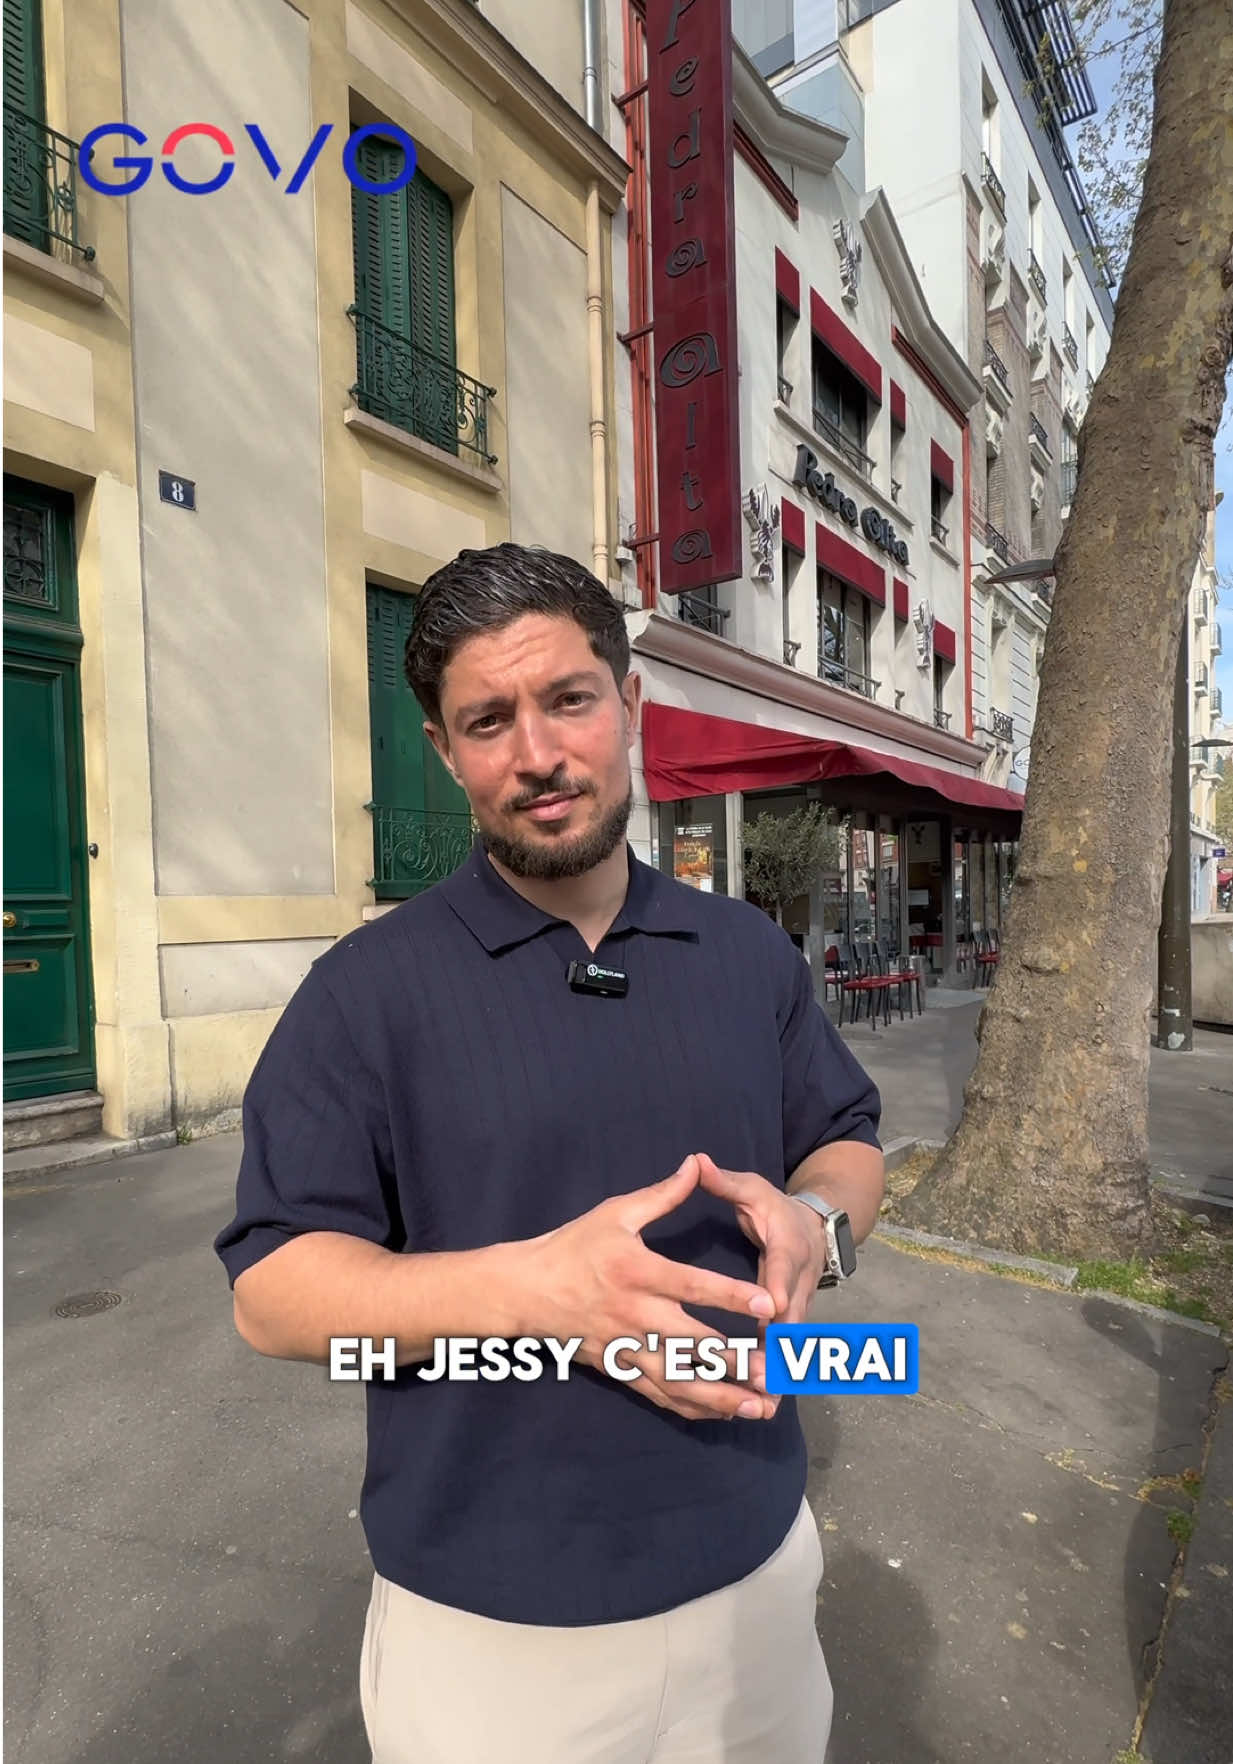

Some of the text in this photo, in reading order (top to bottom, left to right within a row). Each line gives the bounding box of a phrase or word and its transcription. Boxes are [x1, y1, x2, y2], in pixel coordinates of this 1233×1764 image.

[171, 481, 184, 502] 8
[660, 331, 723, 564] Alta
[792, 443, 910, 566] Pedra Alta
